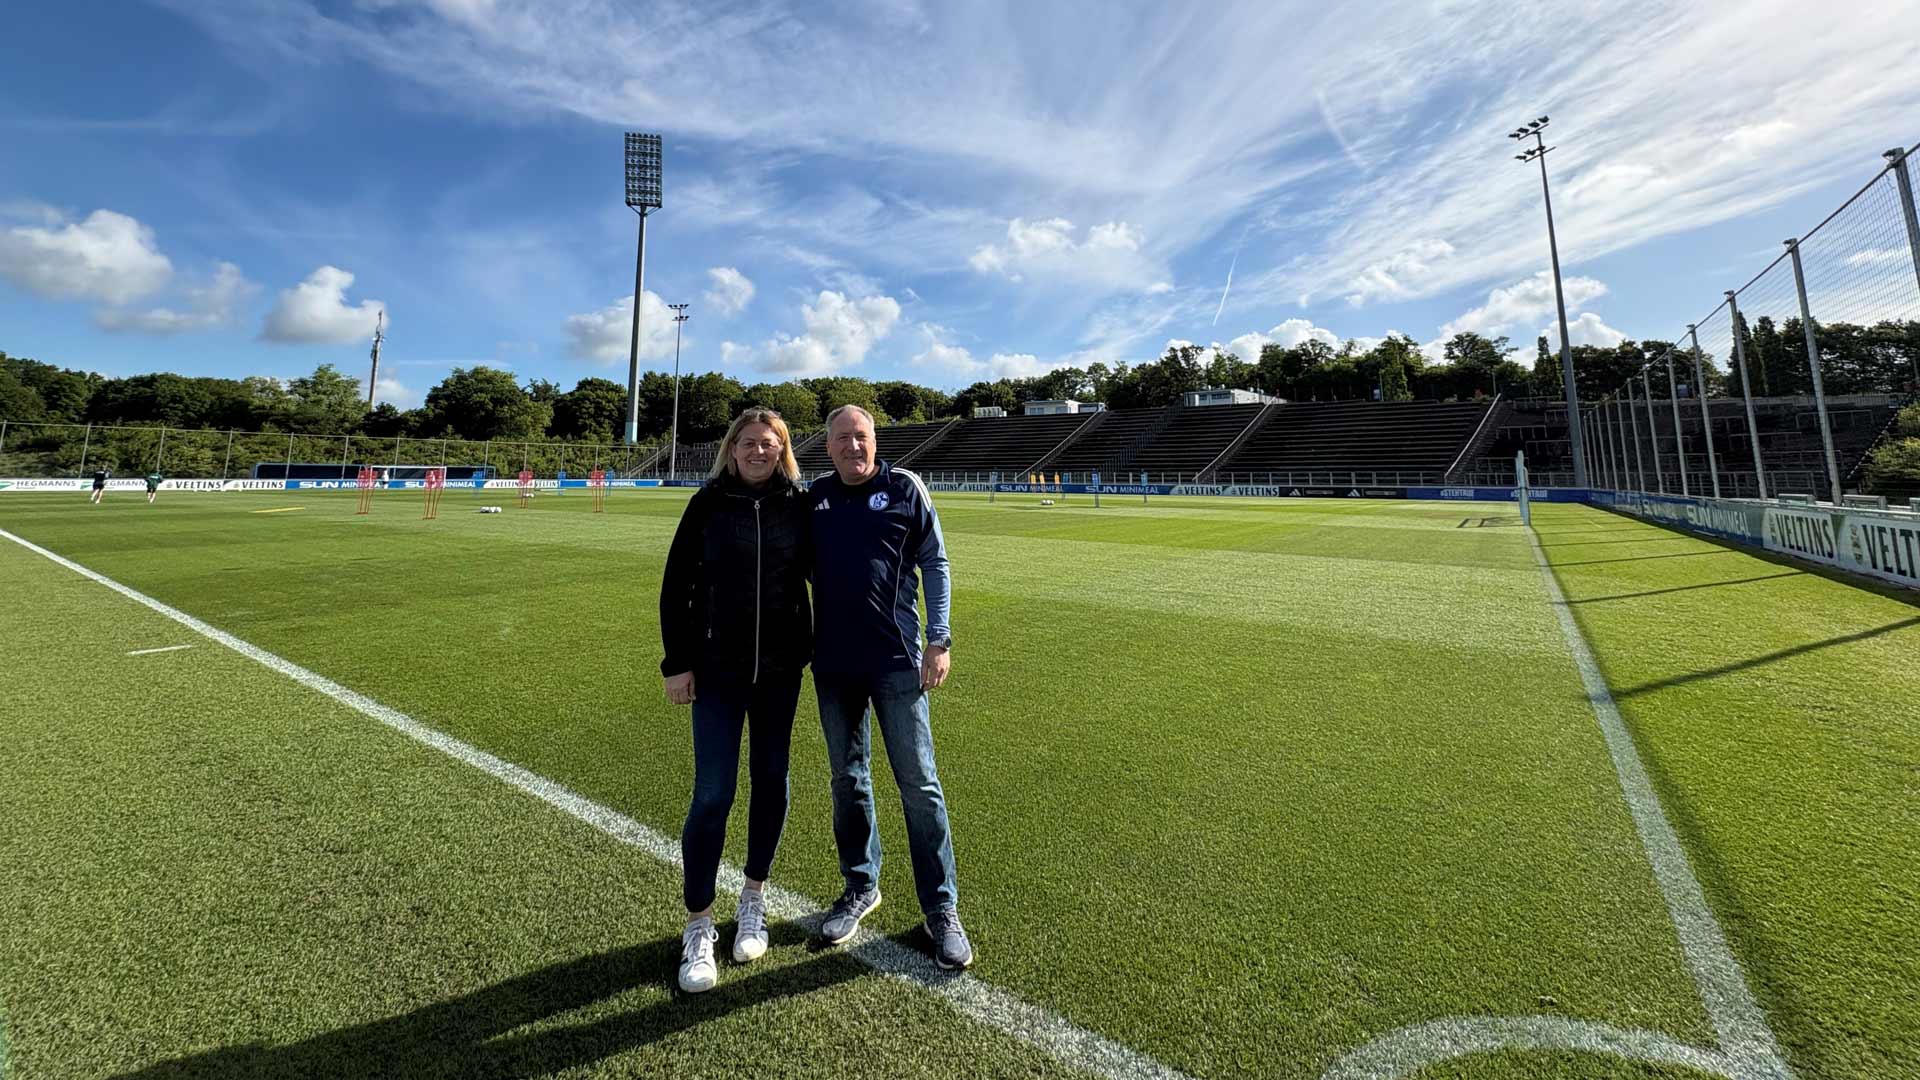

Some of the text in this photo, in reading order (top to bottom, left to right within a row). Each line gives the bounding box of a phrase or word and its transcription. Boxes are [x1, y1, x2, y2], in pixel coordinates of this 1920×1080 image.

[176, 481, 221, 489] VELTINS
[242, 481, 284, 489] VELTINS
[1000, 482, 1028, 492] SUN
[1085, 485, 1159, 494] SUN MINIMEAL
[1184, 486, 1221, 496] VELTINS
[1238, 487, 1278, 497] VELTINS
[1686, 505, 1712, 529] SUN
[1775, 513, 1834, 560] VELTINS
